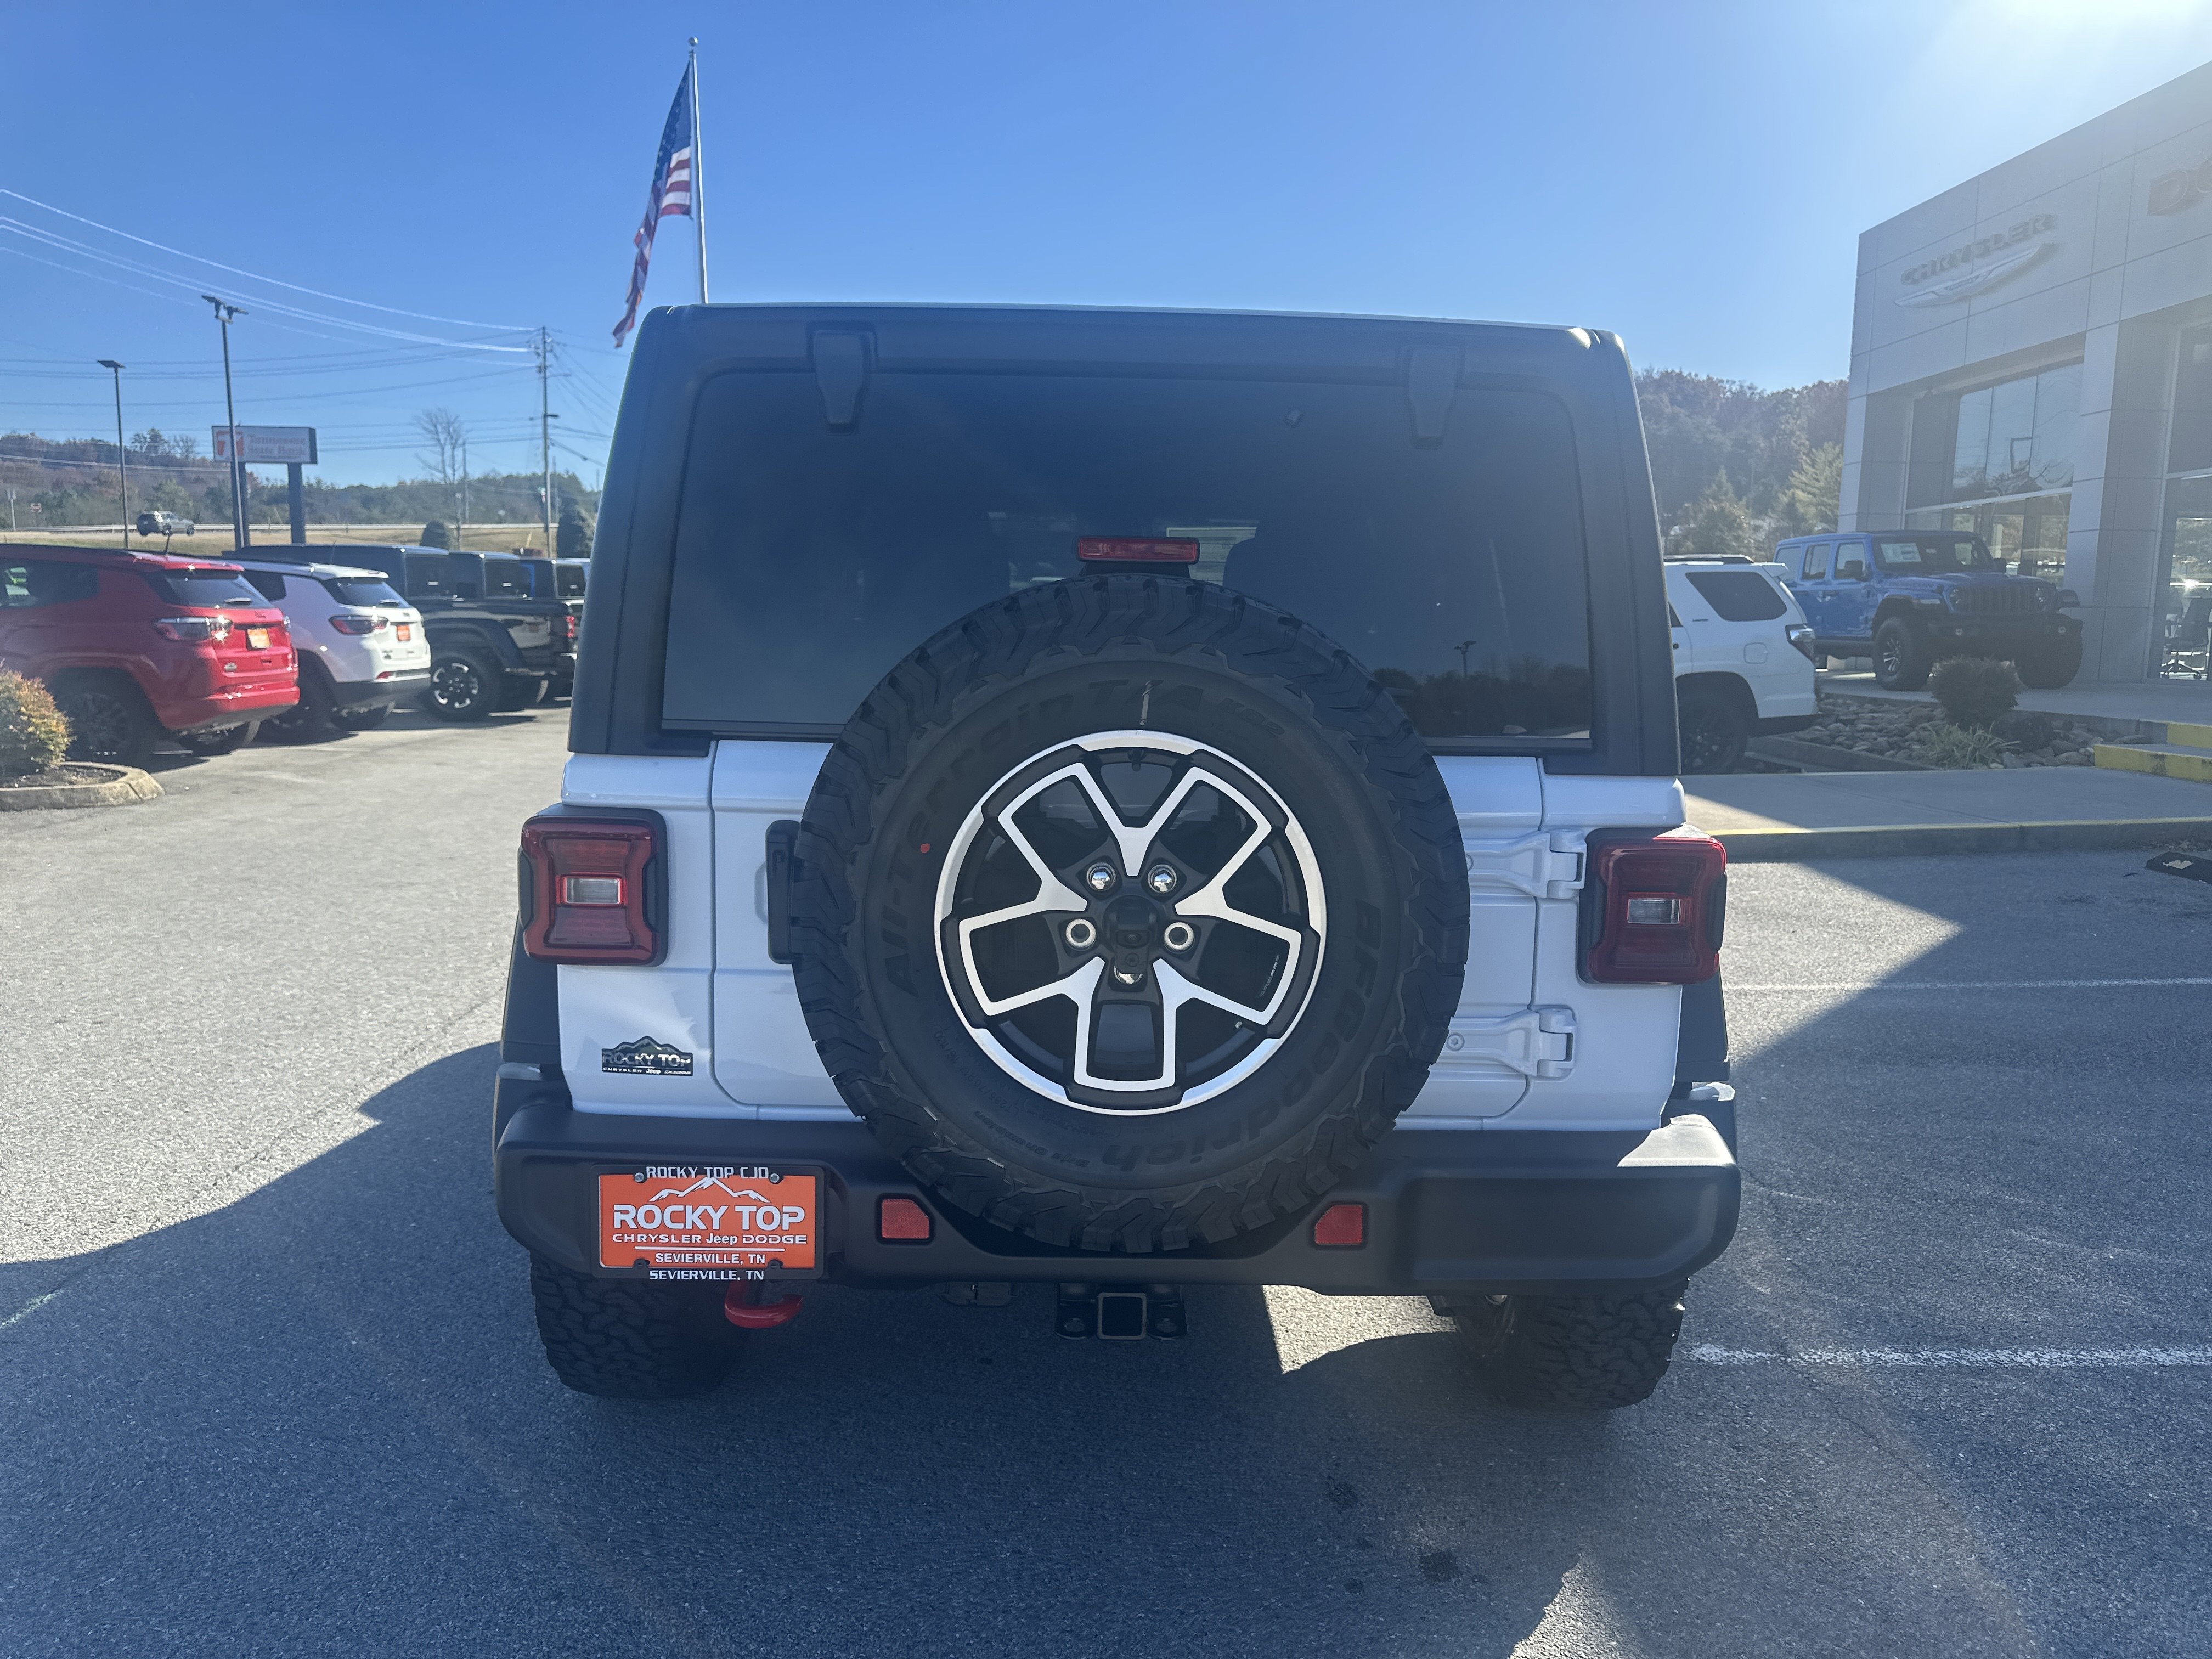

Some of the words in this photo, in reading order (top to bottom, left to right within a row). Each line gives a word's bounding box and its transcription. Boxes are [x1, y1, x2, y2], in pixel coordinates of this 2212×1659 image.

[1102, 898, 1381, 1172] BFGoodrich
[602, 1051, 655, 1066] ROCKY
[658, 1053, 692, 1067] TOP
[646, 1166, 698, 1179] ROCKY
[703, 1167, 735, 1179] TOP
[740, 1167, 769, 1179] CJD
[613, 1204, 729, 1230] ROCKY
[735, 1205, 805, 1231] TOP
[612, 1233, 702, 1244] CHRYSLER
[706, 1233, 738, 1245] Jeep
[742, 1234, 807, 1244] DODGE
[655, 1252, 743, 1265] SEVIERVILLE,
[748, 1254, 765, 1264] TN
[649, 1269, 741, 1281] SEVIERVILLE,
[746, 1270, 764, 1280] TN
